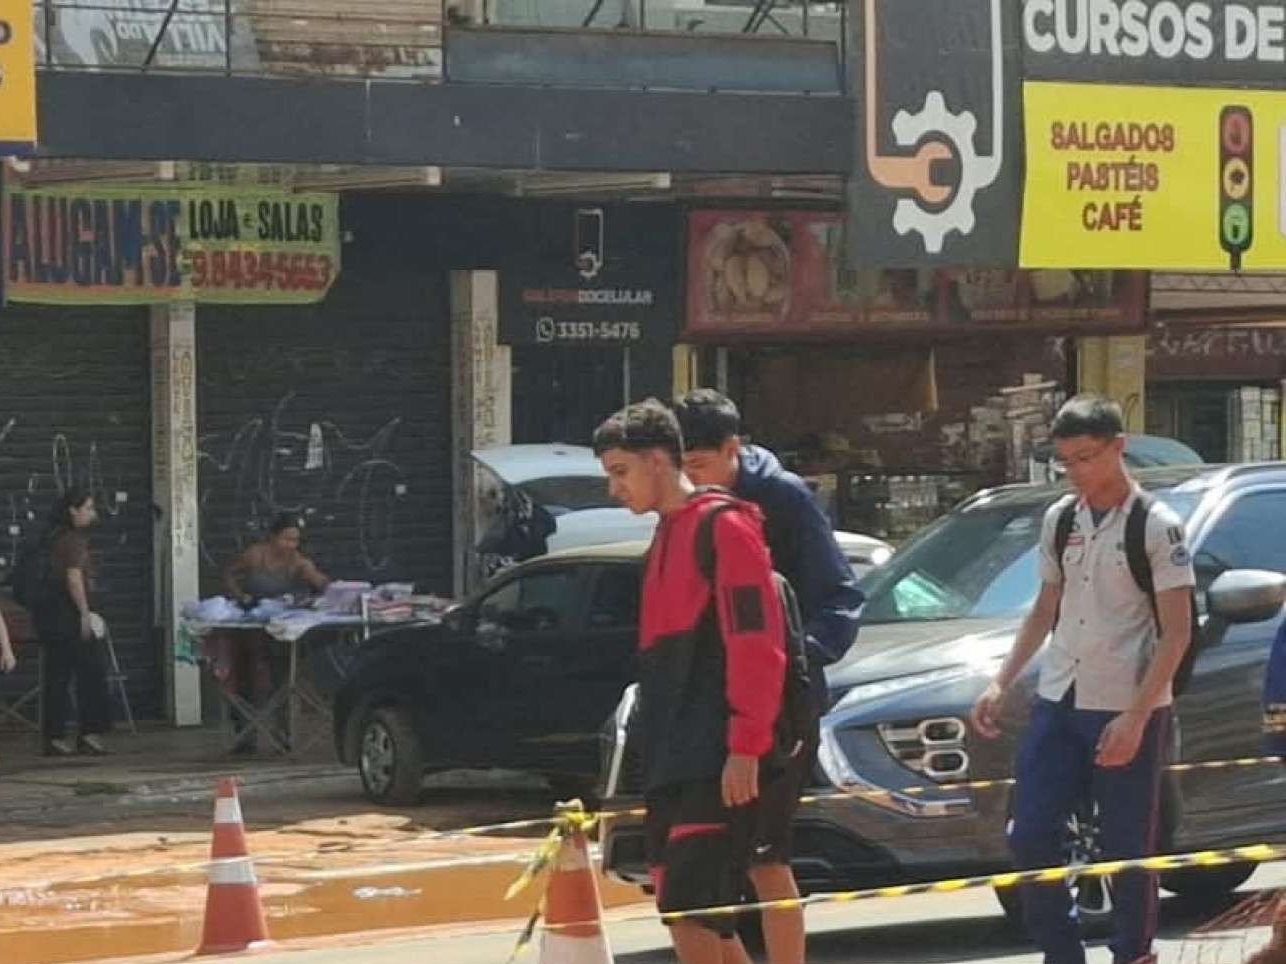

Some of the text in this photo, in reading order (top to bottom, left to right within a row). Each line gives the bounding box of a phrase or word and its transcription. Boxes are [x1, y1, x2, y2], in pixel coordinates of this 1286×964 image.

[1023, 0, 1286, 61] CURSOS DE
[1050, 121, 1176, 152] SALGADOS
[1066, 155, 1159, 191] PASTÉIS
[189, 200, 240, 240] LOJA
[258, 202, 324, 242] SALAS
[1082, 195, 1142, 231] CAFÉ
